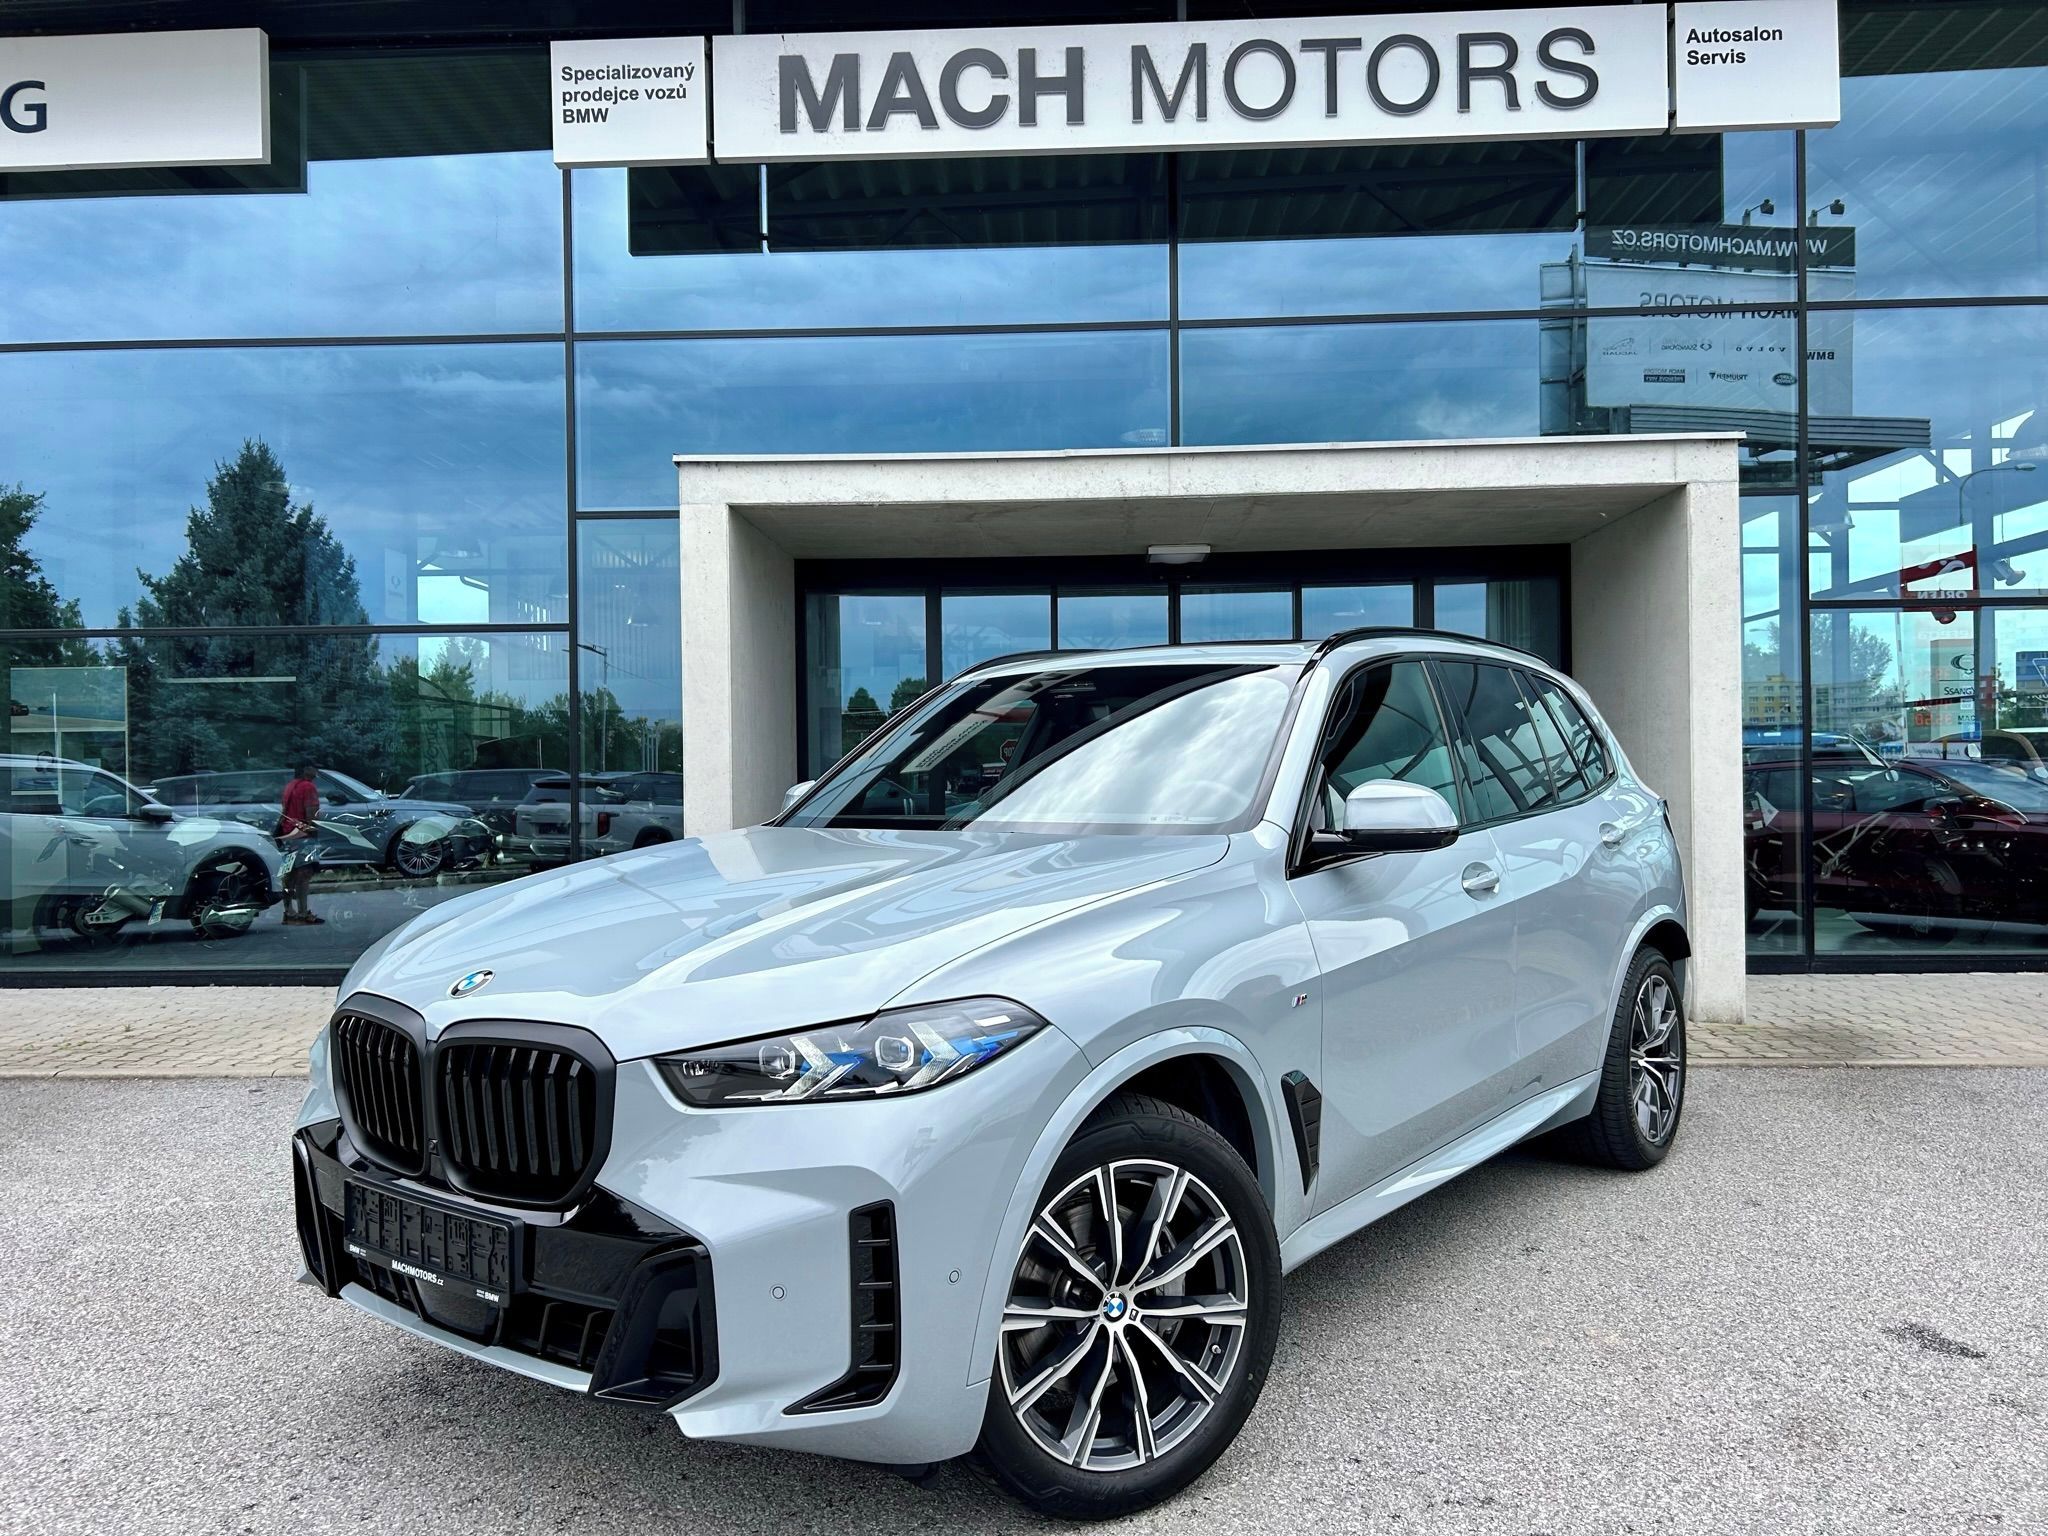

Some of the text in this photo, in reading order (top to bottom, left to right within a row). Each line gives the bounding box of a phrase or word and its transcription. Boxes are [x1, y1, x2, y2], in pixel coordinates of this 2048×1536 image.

[1686, 26, 1783, 44] Autosalon
[1687, 48, 1746, 65] Servis
[561, 62, 695, 84] Specializovaný
[777, 27, 1600, 134] MACH MOTORS
[562, 83, 687, 106] prodejce vozů
[562, 107, 609, 124] BMW
[485, 1292, 500, 1302] BMW
